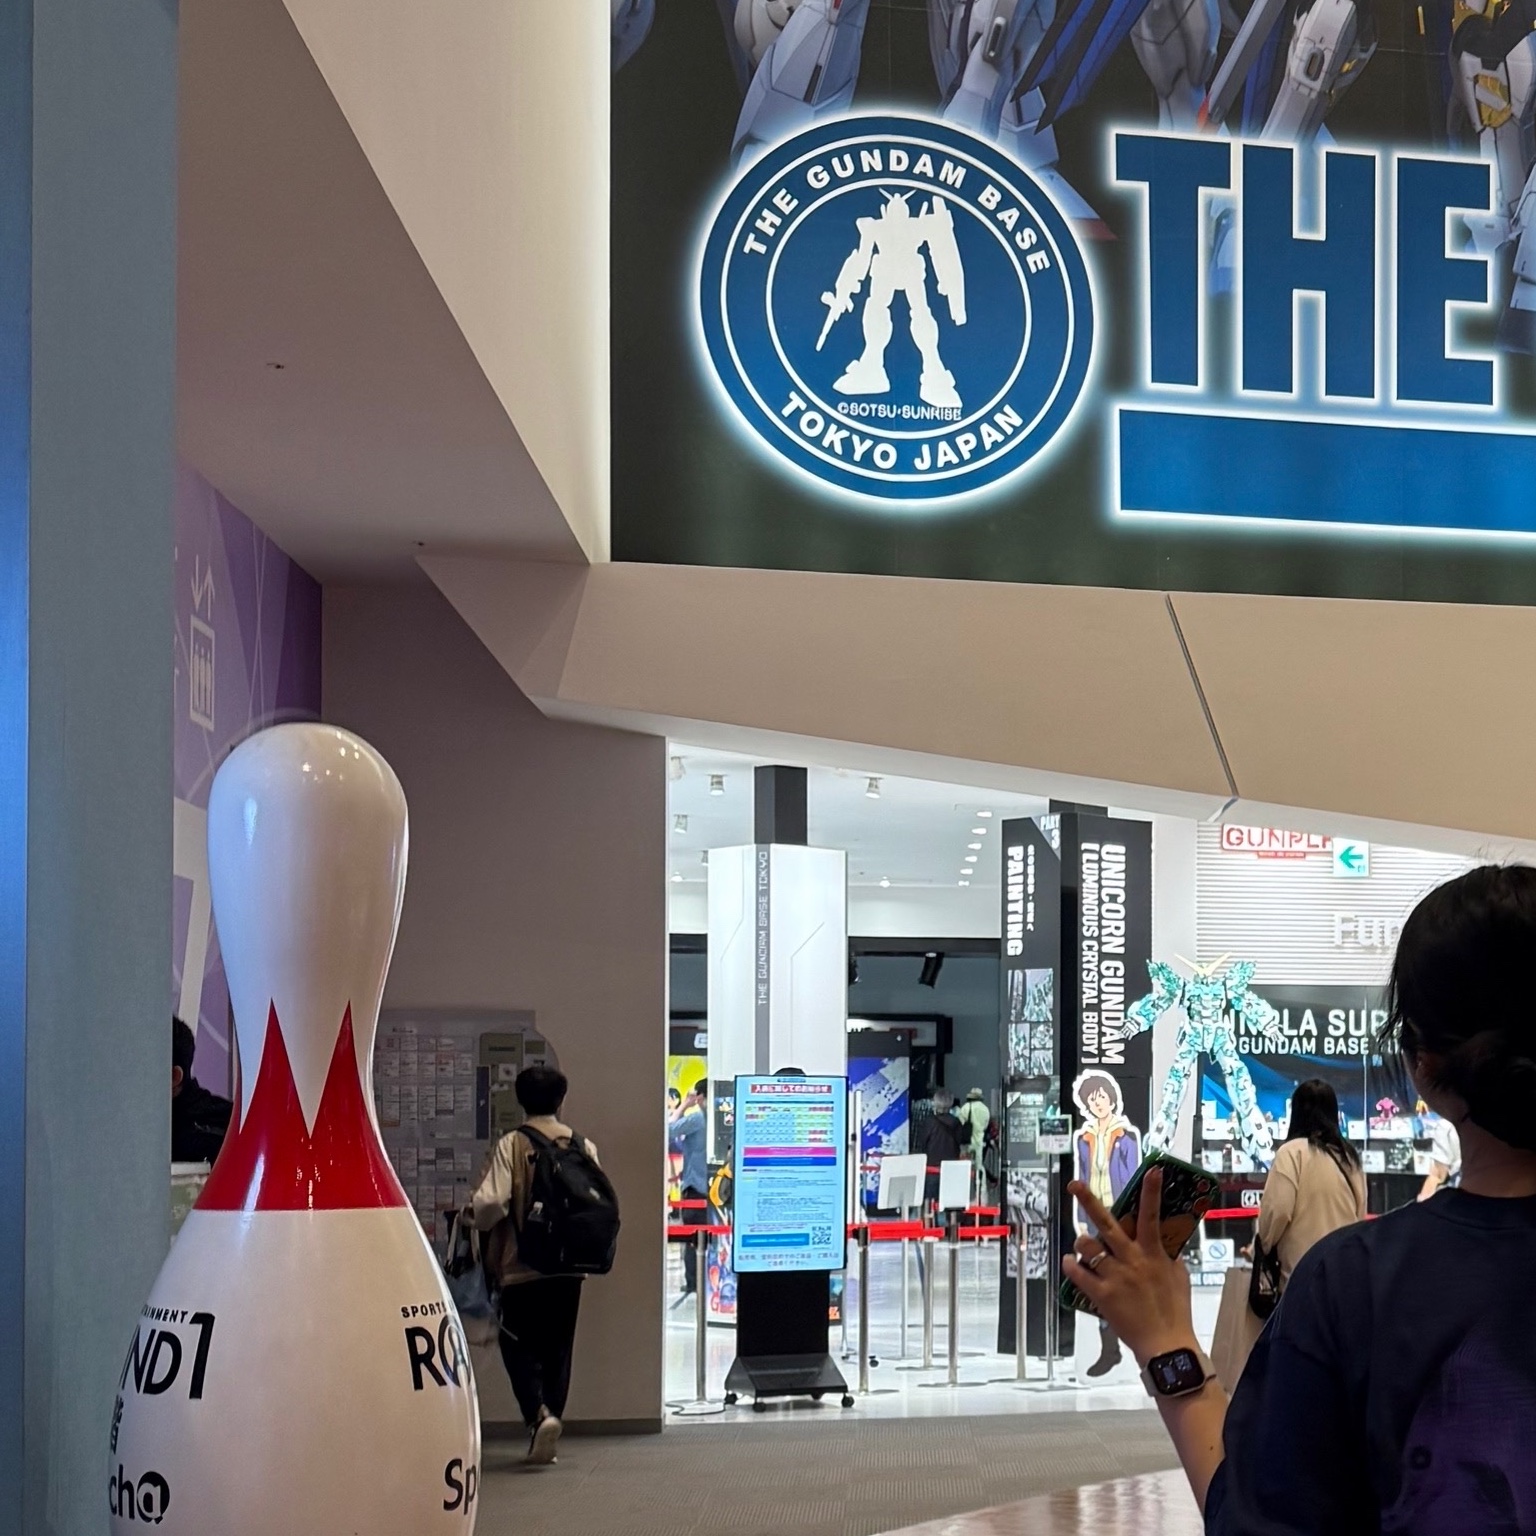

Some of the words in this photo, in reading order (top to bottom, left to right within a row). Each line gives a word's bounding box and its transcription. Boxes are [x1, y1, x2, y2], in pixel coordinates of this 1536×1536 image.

[744, 188, 798, 257] THE
[807, 148, 966, 190] GUNDAM
[977, 184, 1050, 275] BASE
[1114, 131, 1494, 406] THE
[779, 391, 898, 471] TOKYO
[912, 403, 1025, 472] JAPAN
[1040, 815, 1060, 830] PART
[1051, 829, 1060, 850] 3
[1007, 845, 1024, 956] PAINTING
[1100, 843, 1126, 954] UNICORN
[1081, 940, 1099, 1008] CRYSTAL
[1100, 960, 1126, 1065] GUNDAM
[1239, 1036, 1317, 1056] GUNDAM
[1323, 1036, 1369, 1056] BASE
[119, 1311, 216, 1400] ND1
